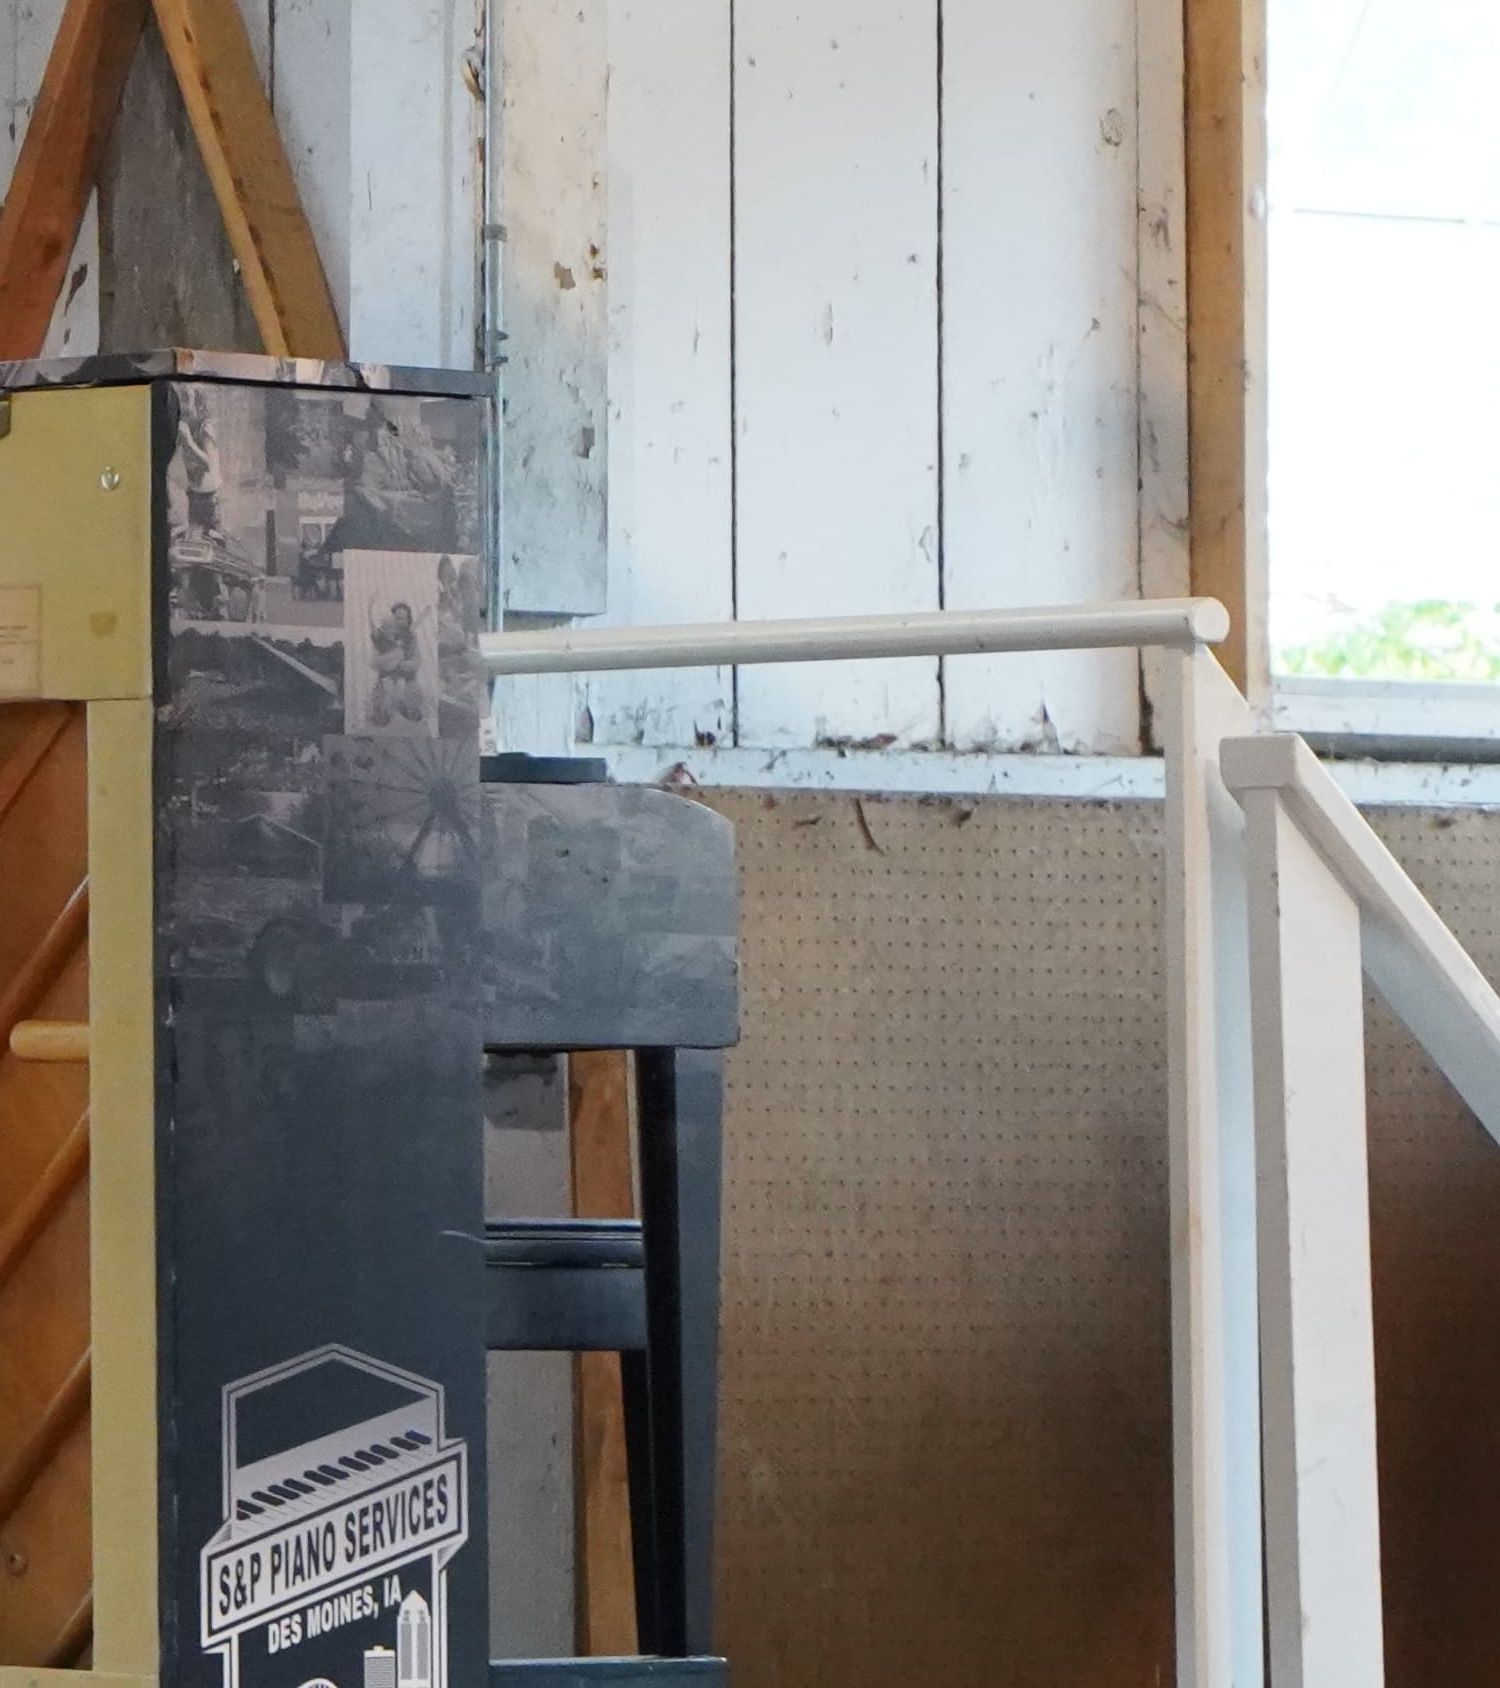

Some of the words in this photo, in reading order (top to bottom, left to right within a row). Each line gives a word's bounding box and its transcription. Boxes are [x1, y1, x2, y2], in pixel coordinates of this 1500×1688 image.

[219, 1551, 261, 1616] S&P
[270, 1521, 336, 1595] PIANO
[344, 1473, 448, 1563] SERVICES
[267, 1613, 303, 1654] DES
[306, 1585, 379, 1639] MOINES,
[383, 1574, 402, 1609] IA
